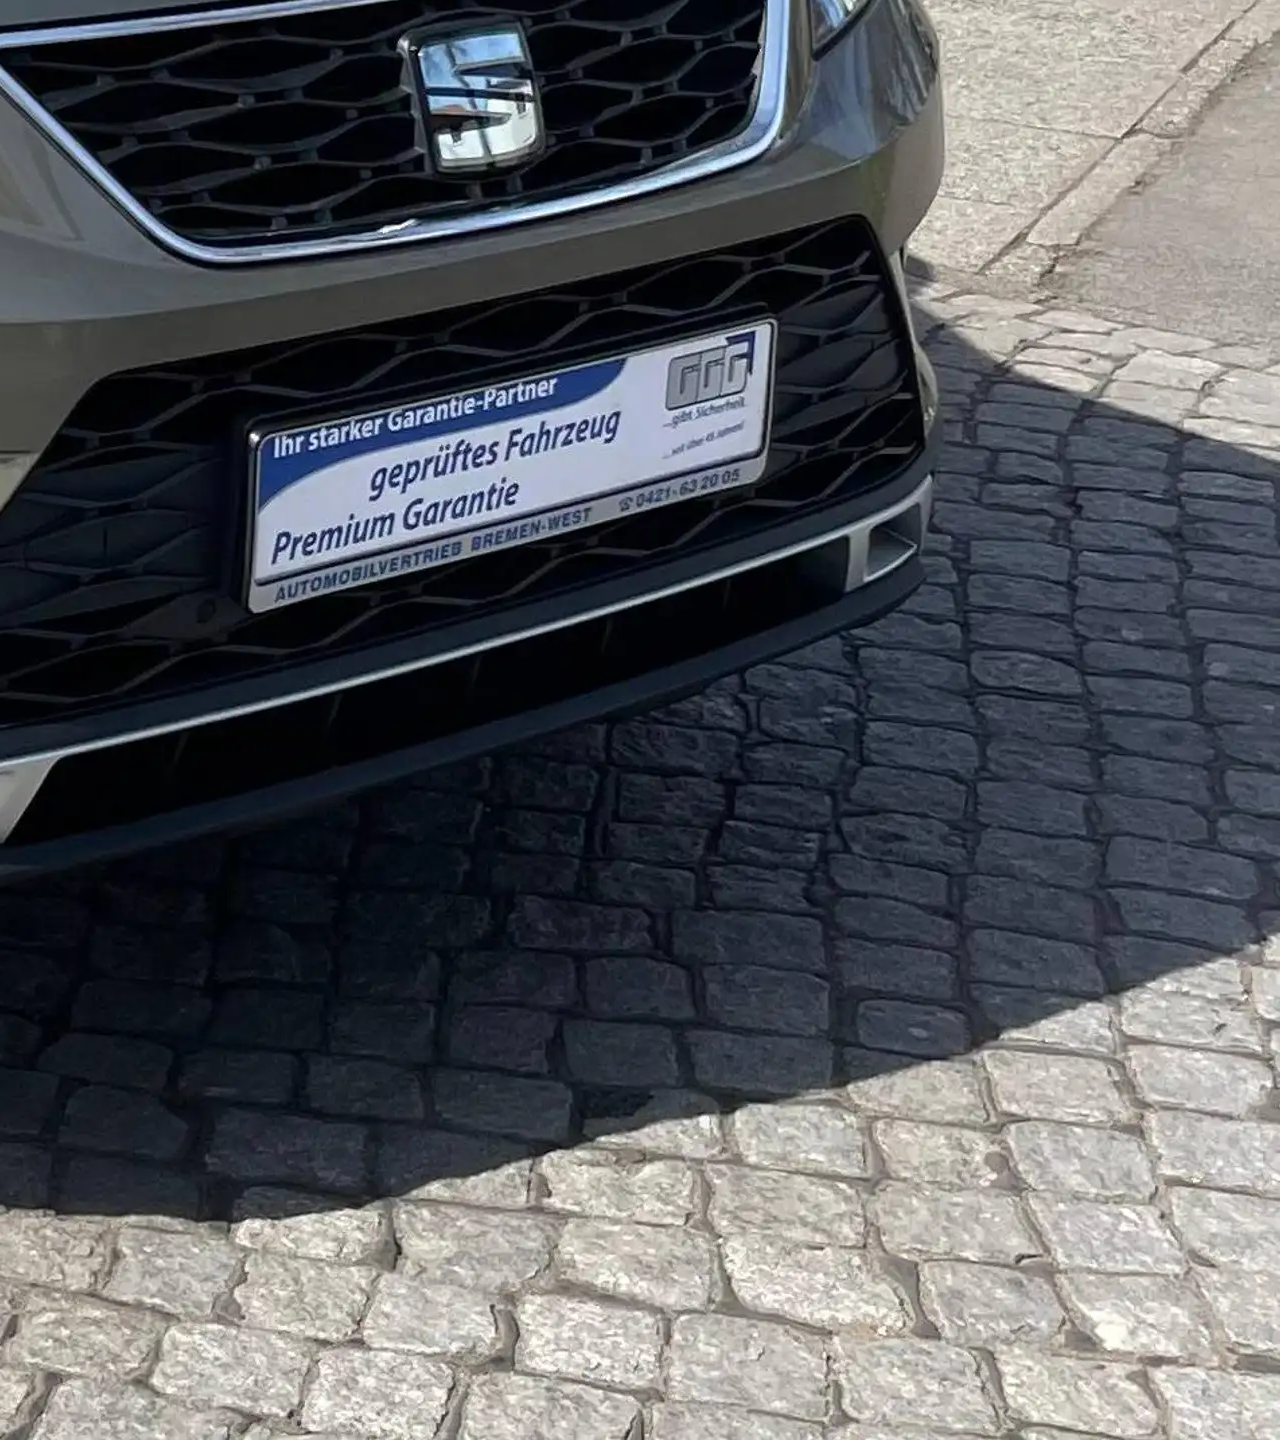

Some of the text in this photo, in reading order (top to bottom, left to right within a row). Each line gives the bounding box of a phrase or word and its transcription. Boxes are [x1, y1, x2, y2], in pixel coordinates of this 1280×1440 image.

[273, 377, 558, 458] Ihr starker Garantie-Partner
[369, 438, 500, 502] geprüftes
[504, 410, 622, 462] Fahrzeug
[271, 477, 520, 566] Premium Garantie
[273, 540, 463, 603] AUTOMOBILVERTRIEB
[470, 507, 592, 553] BREMEN-WEST
